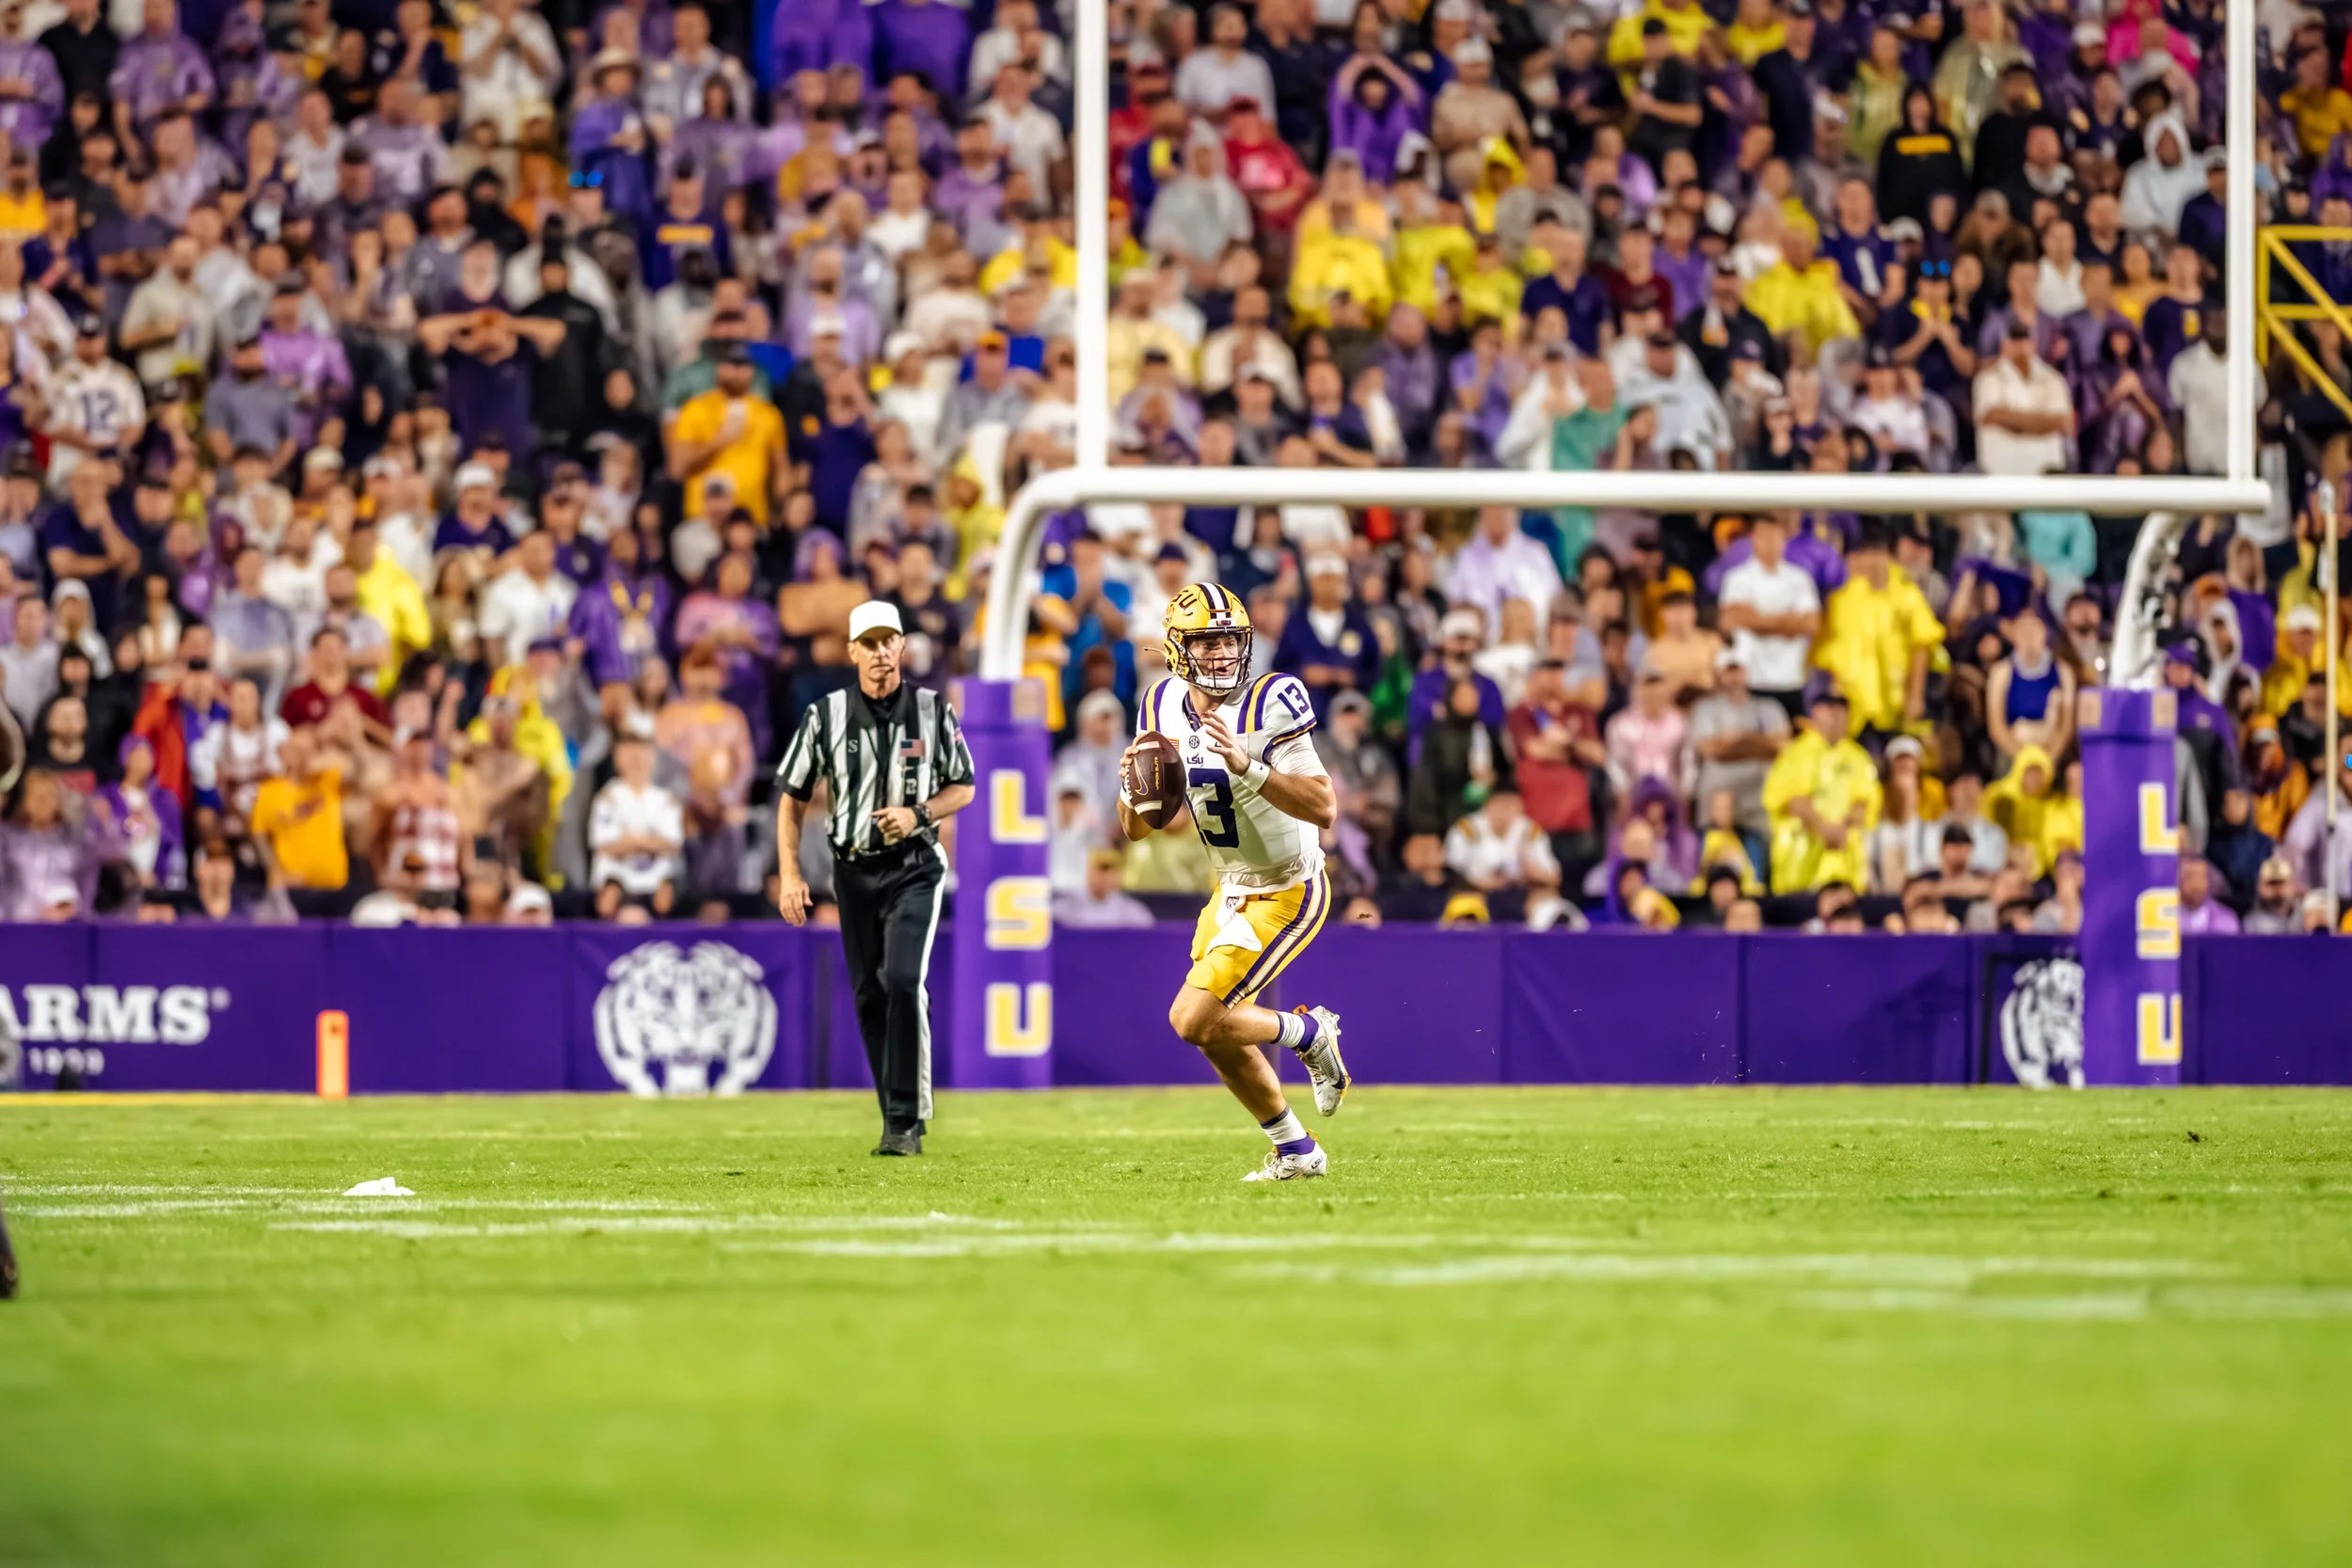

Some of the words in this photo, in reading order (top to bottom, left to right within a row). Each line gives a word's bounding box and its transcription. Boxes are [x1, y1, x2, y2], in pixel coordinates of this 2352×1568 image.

[1277, 682, 1310, 721] 13
[848, 739, 859, 752] S
[1186, 752, 1204, 765] LSU
[1187, 768, 1239, 847] 3
[986, 769, 1053, 1056] LSU
[2136, 782, 2183, 1065] LSU
